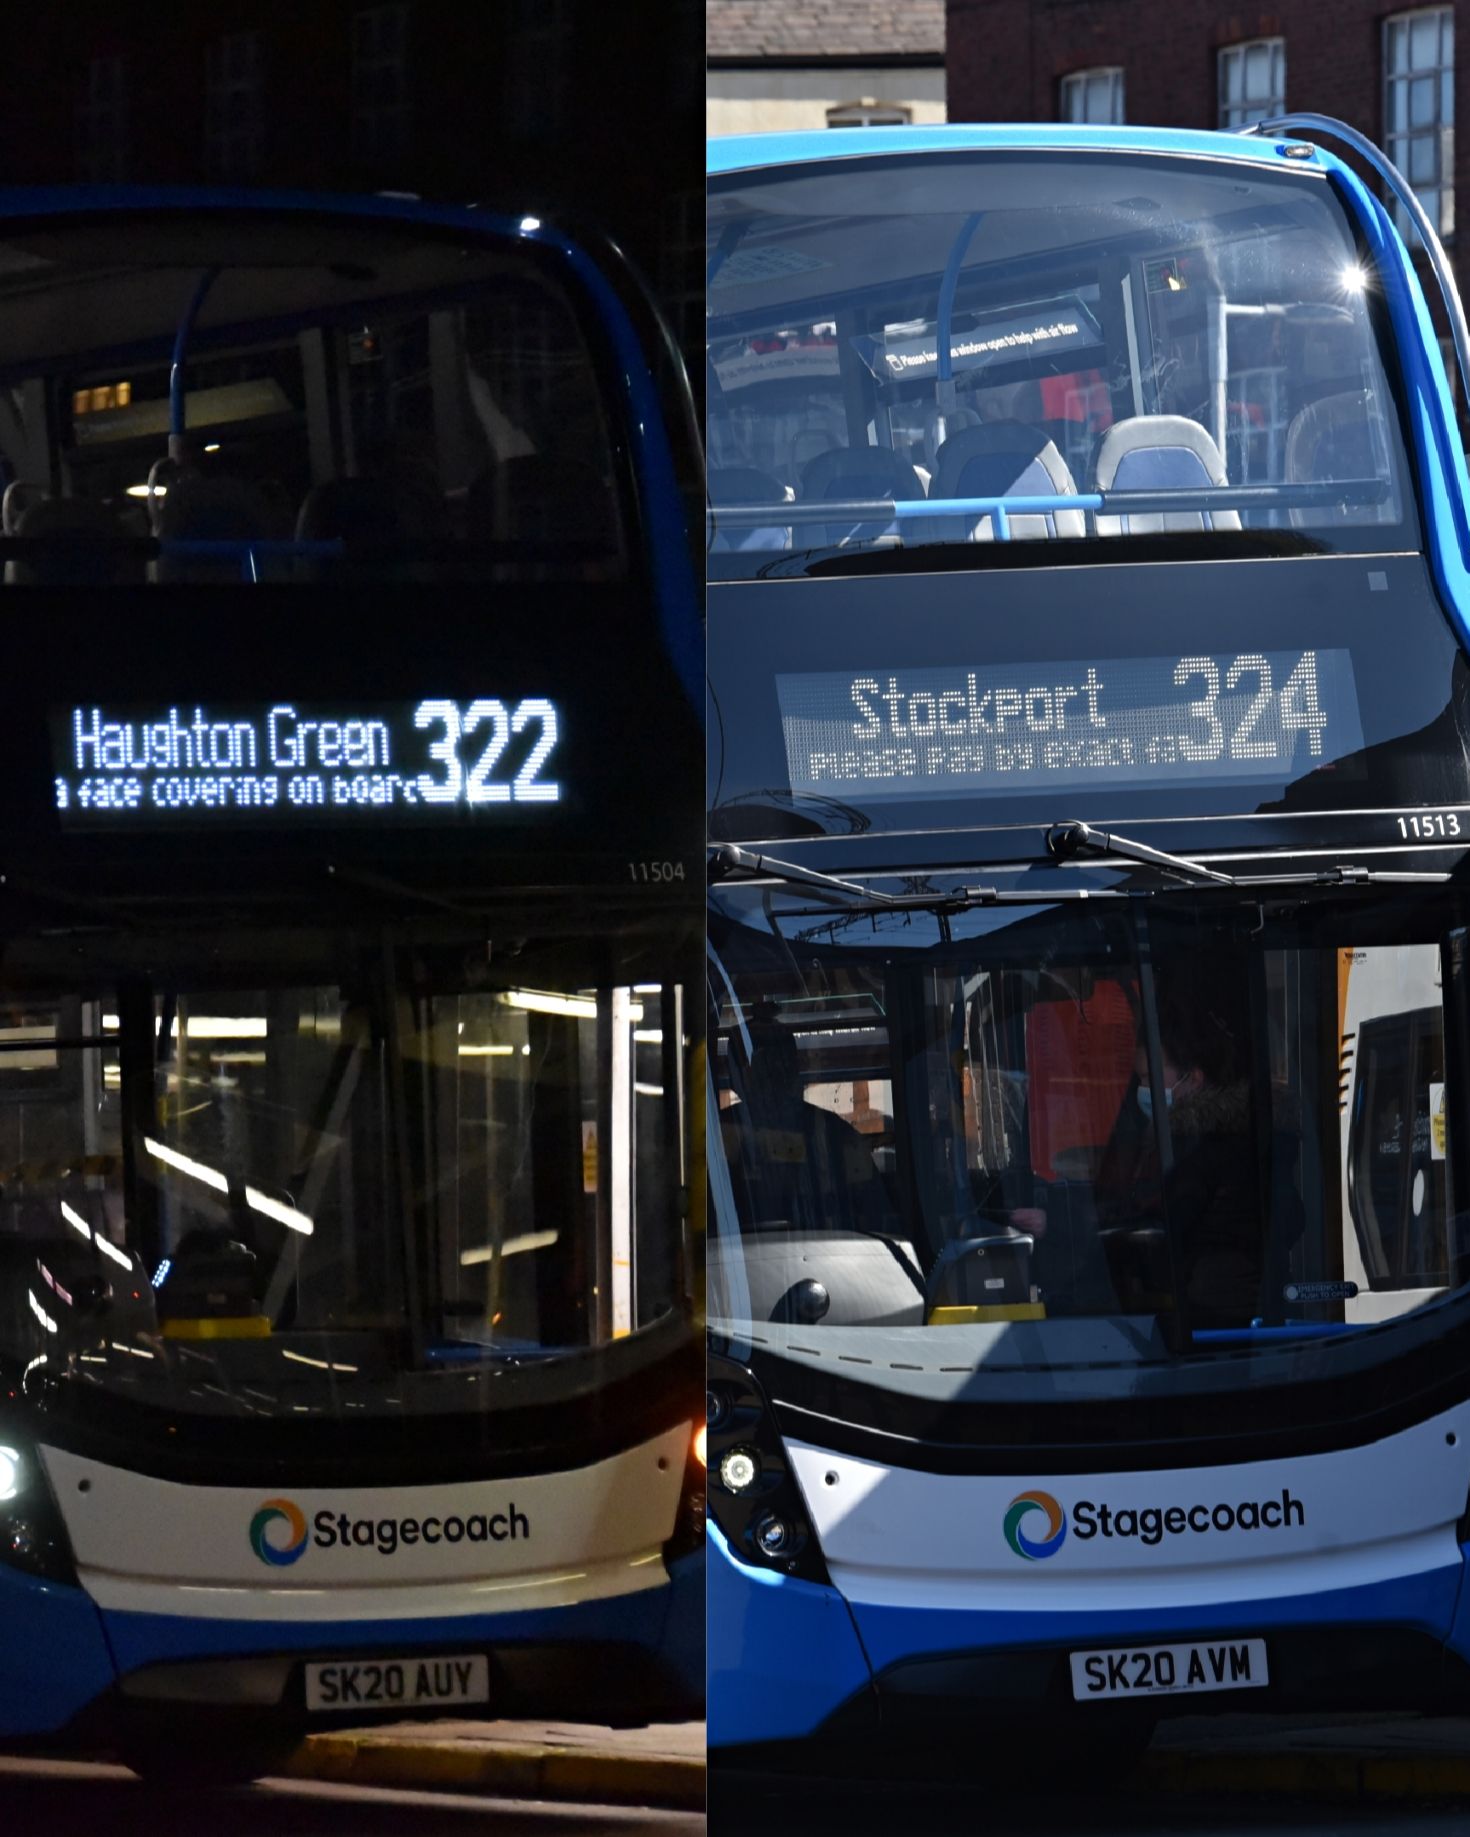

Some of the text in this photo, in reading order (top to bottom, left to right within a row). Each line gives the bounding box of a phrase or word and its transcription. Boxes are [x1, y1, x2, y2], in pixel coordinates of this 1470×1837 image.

[850, 650, 1328, 762] Stockport 324
[74, 698, 560, 802] Haughton Green 322
[77, 776, 142, 807] face
[152, 775, 278, 806] covering
[289, 775, 325, 804] on
[1397, 813, 1461, 839] 11513
[628, 861, 686, 882] 11504
[313, 1502, 530, 1555] Stagecoach
[1072, 1488, 1305, 1545] Stagecoach
[319, 1661, 473, 1703] SK20 AUY
[1084, 1644, 1251, 1692] SK20 AVM
